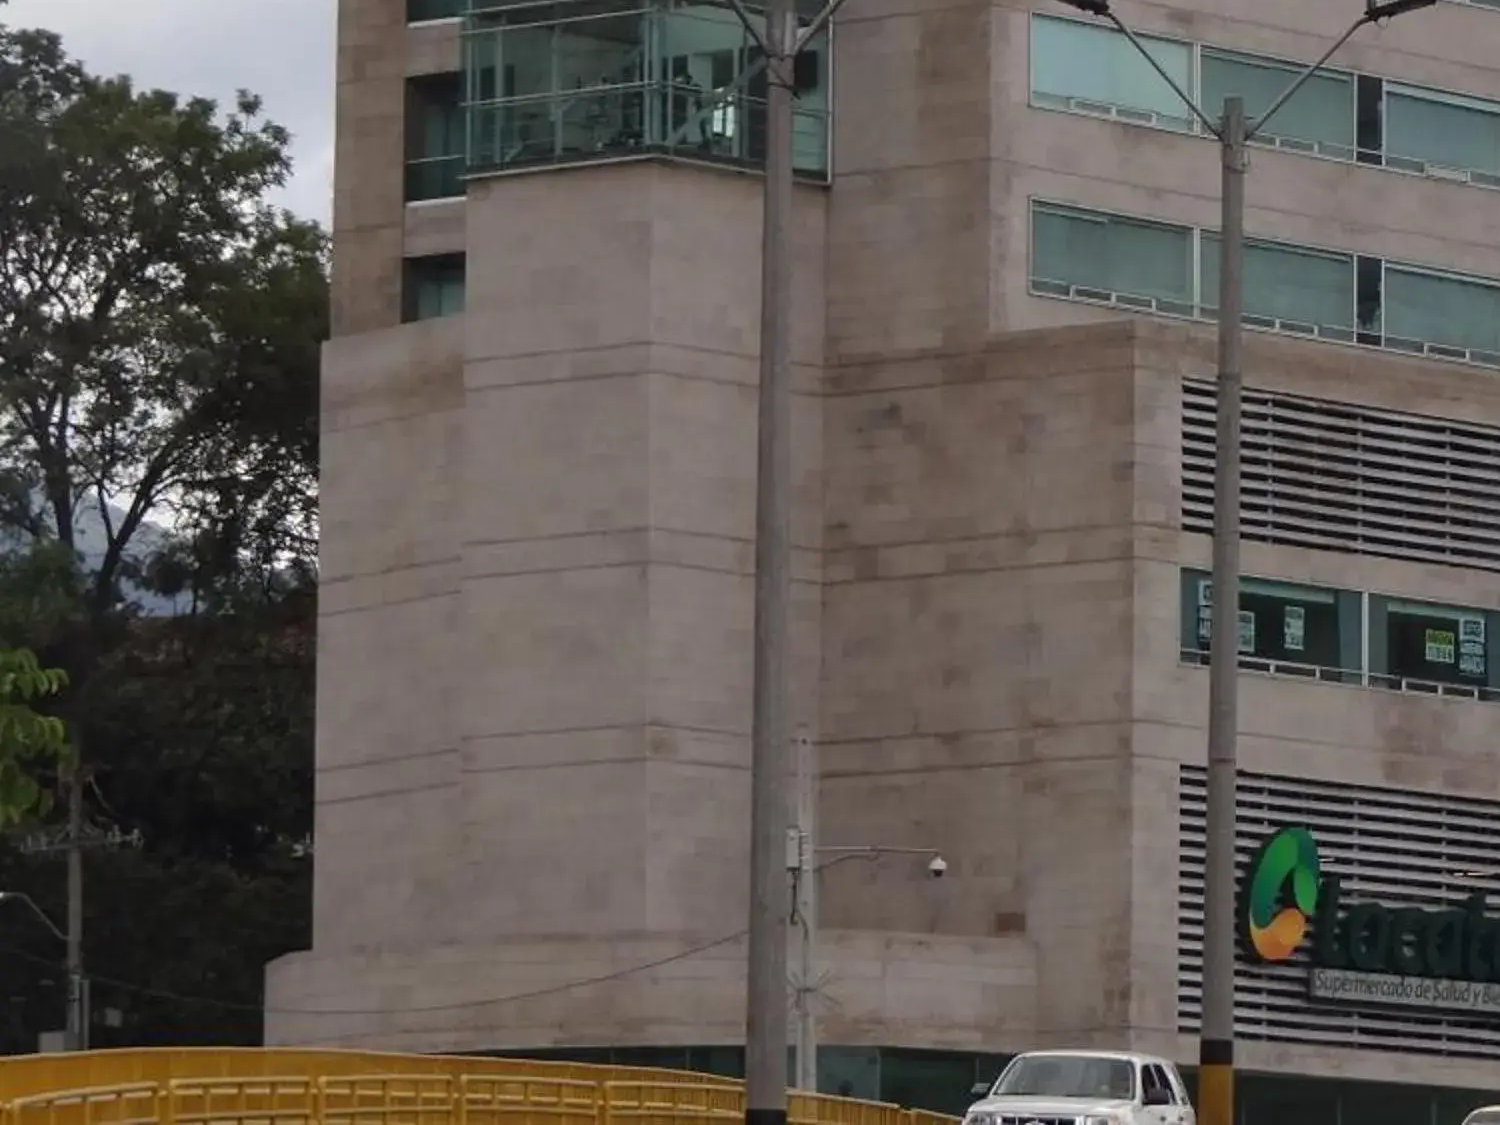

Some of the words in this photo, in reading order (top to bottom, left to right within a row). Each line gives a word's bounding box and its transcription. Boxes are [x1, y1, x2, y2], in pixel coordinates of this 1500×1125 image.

[1314, 969, 1413, 999] Supermercado
[1415, 978, 1431, 1000] de
[1433, 980, 1471, 1002] Salud
[1472, 988, 1480, 1006] y
